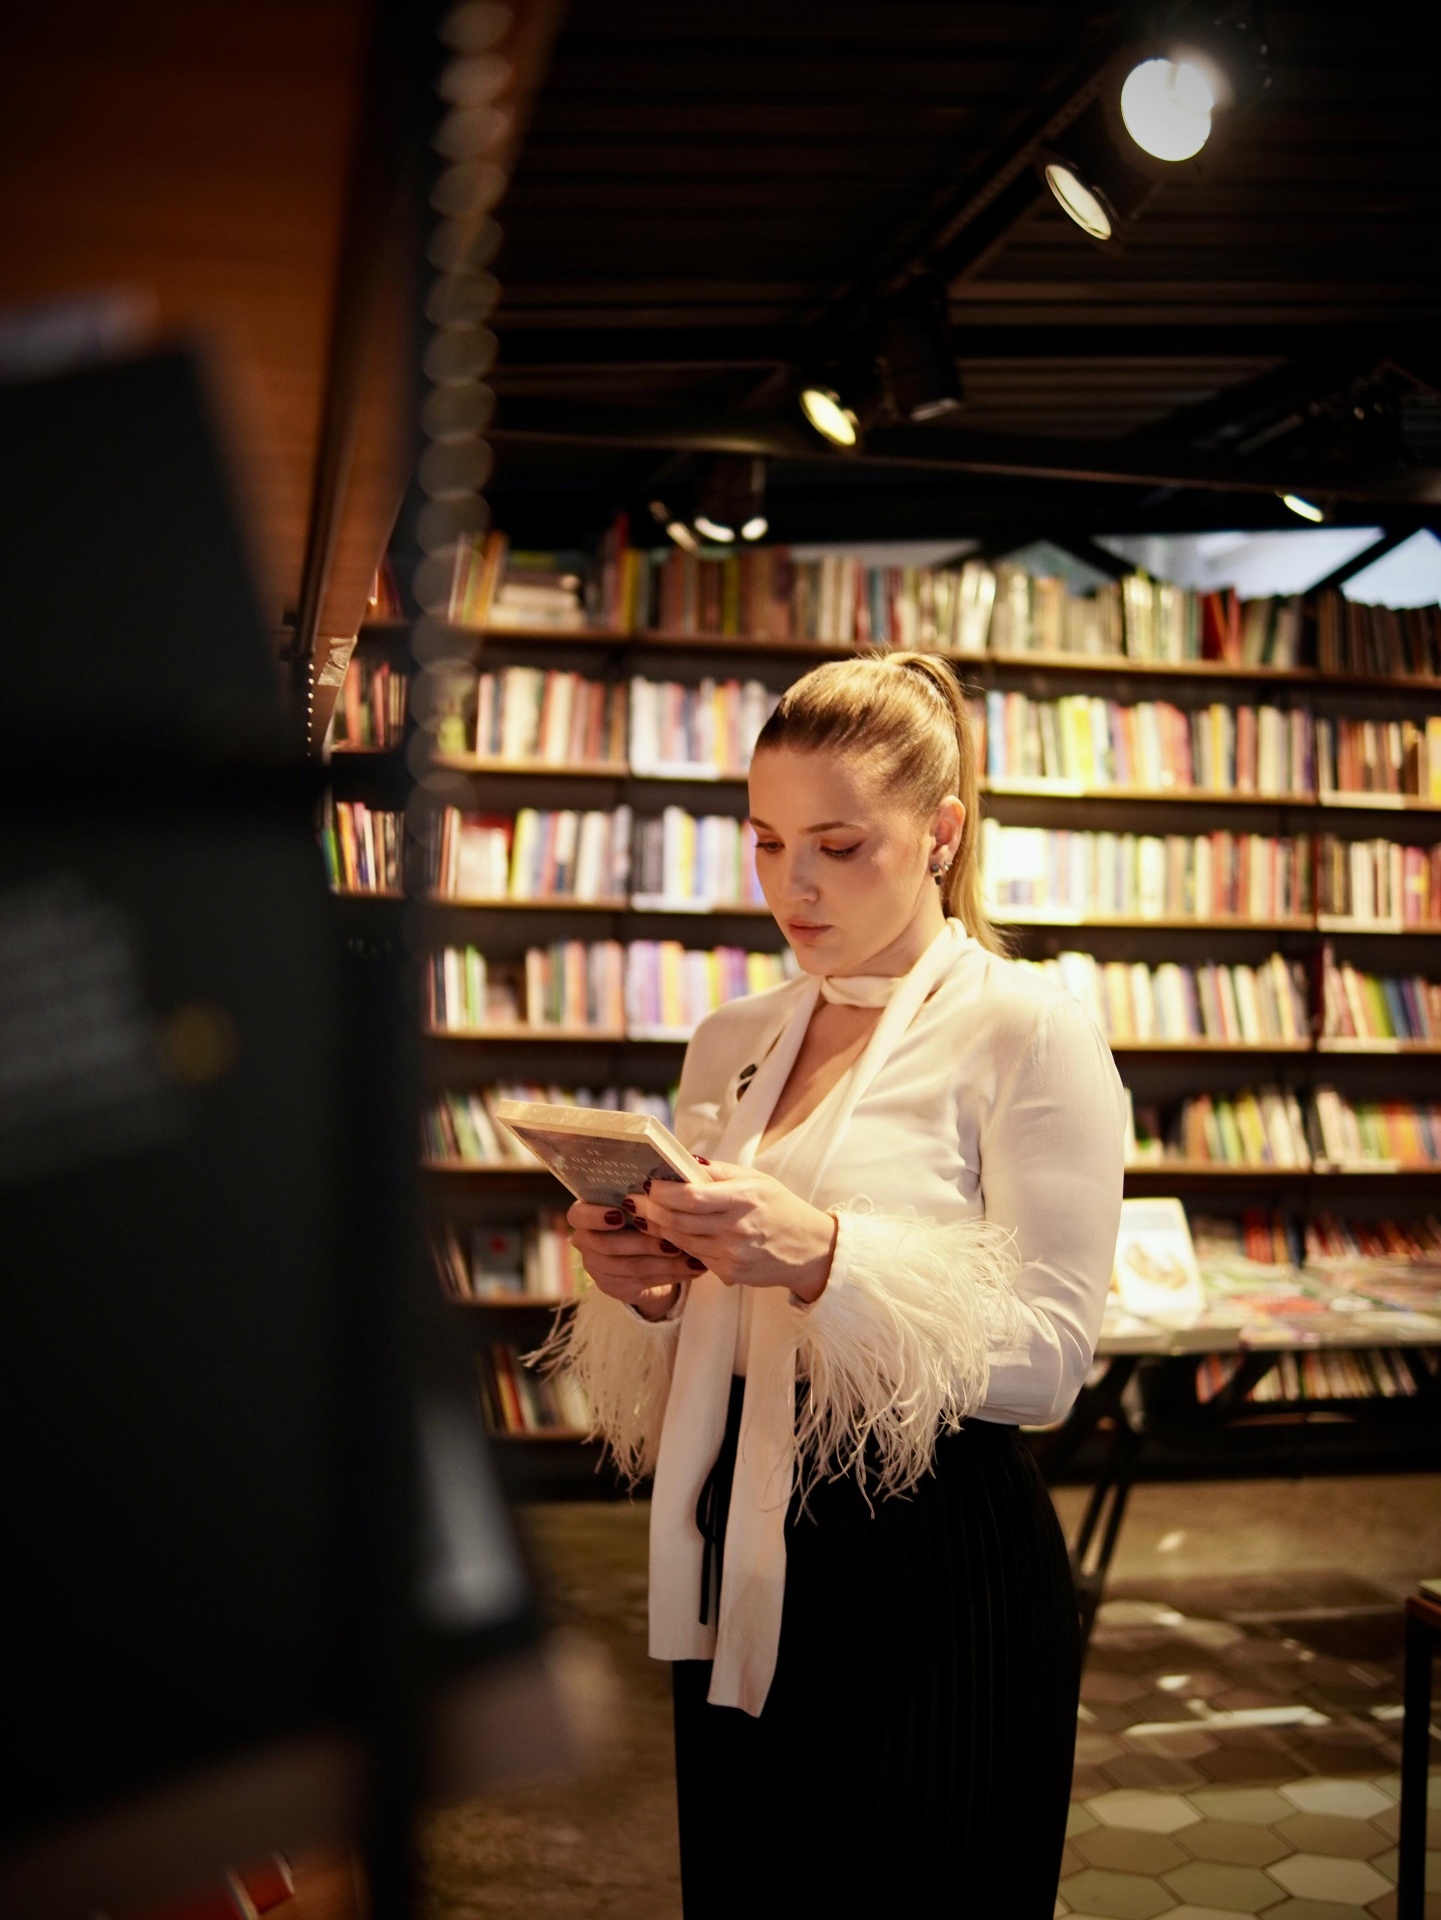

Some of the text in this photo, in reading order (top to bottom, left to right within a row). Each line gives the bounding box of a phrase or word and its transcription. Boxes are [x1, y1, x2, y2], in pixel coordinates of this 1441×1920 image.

[585, 1149, 603, 1157] SE
[570, 1156, 639, 1169] OS GATOS
